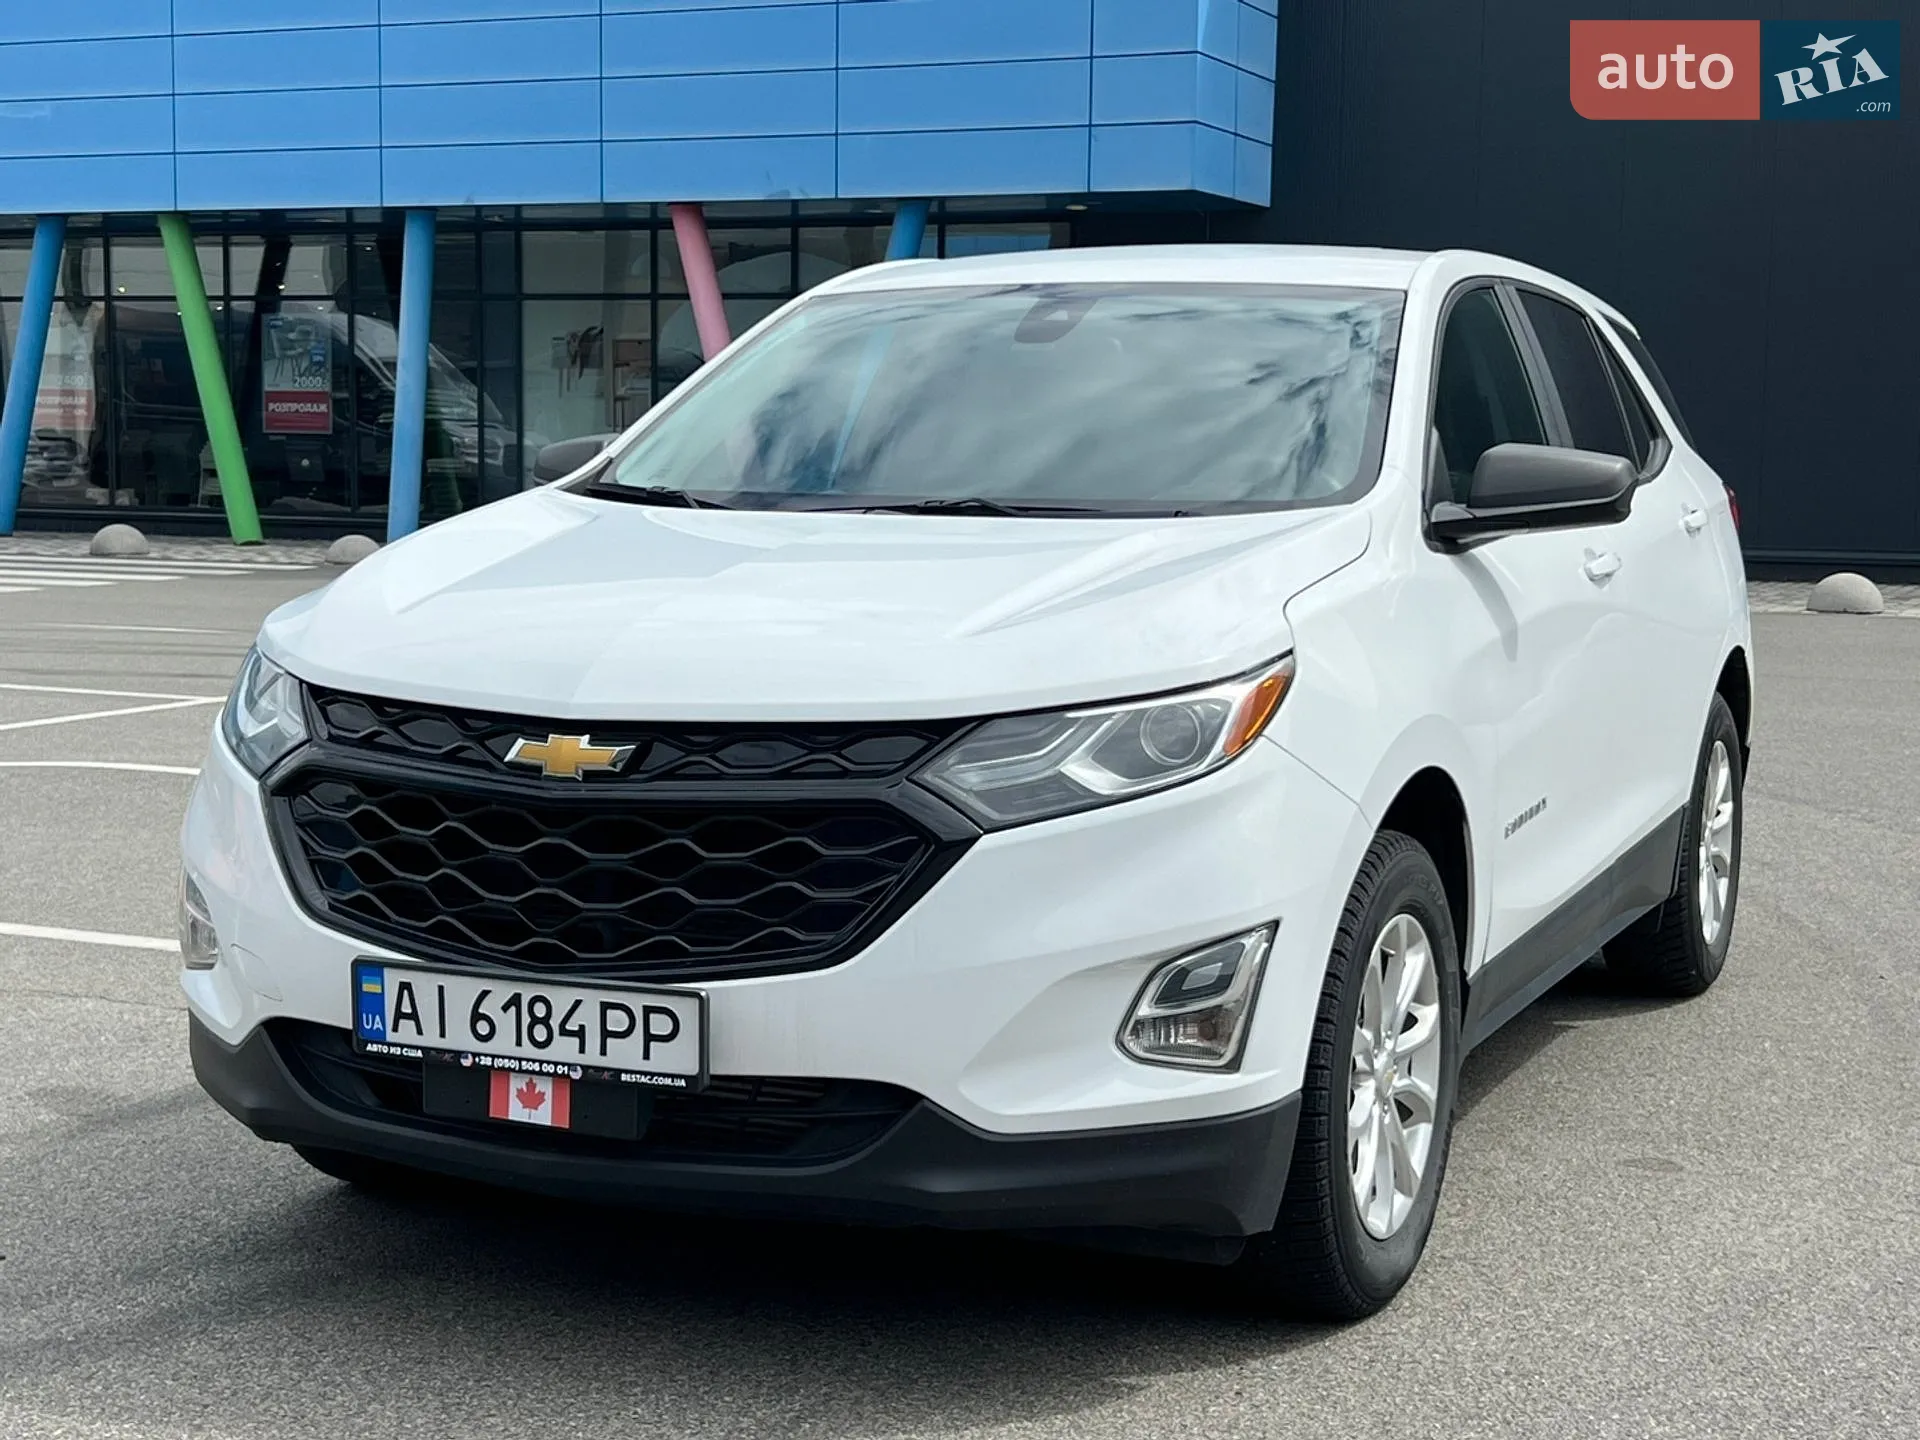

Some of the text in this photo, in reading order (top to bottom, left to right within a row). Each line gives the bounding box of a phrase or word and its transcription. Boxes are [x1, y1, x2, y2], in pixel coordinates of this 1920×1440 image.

[267, 402, 328, 413] РОЗПРОДАЖ
[391, 981, 446, 1039] AI
[362, 1013, 384, 1031] UA
[366, 1043, 389, 1054] АВТО
[402, 1047, 423, 1058] США
